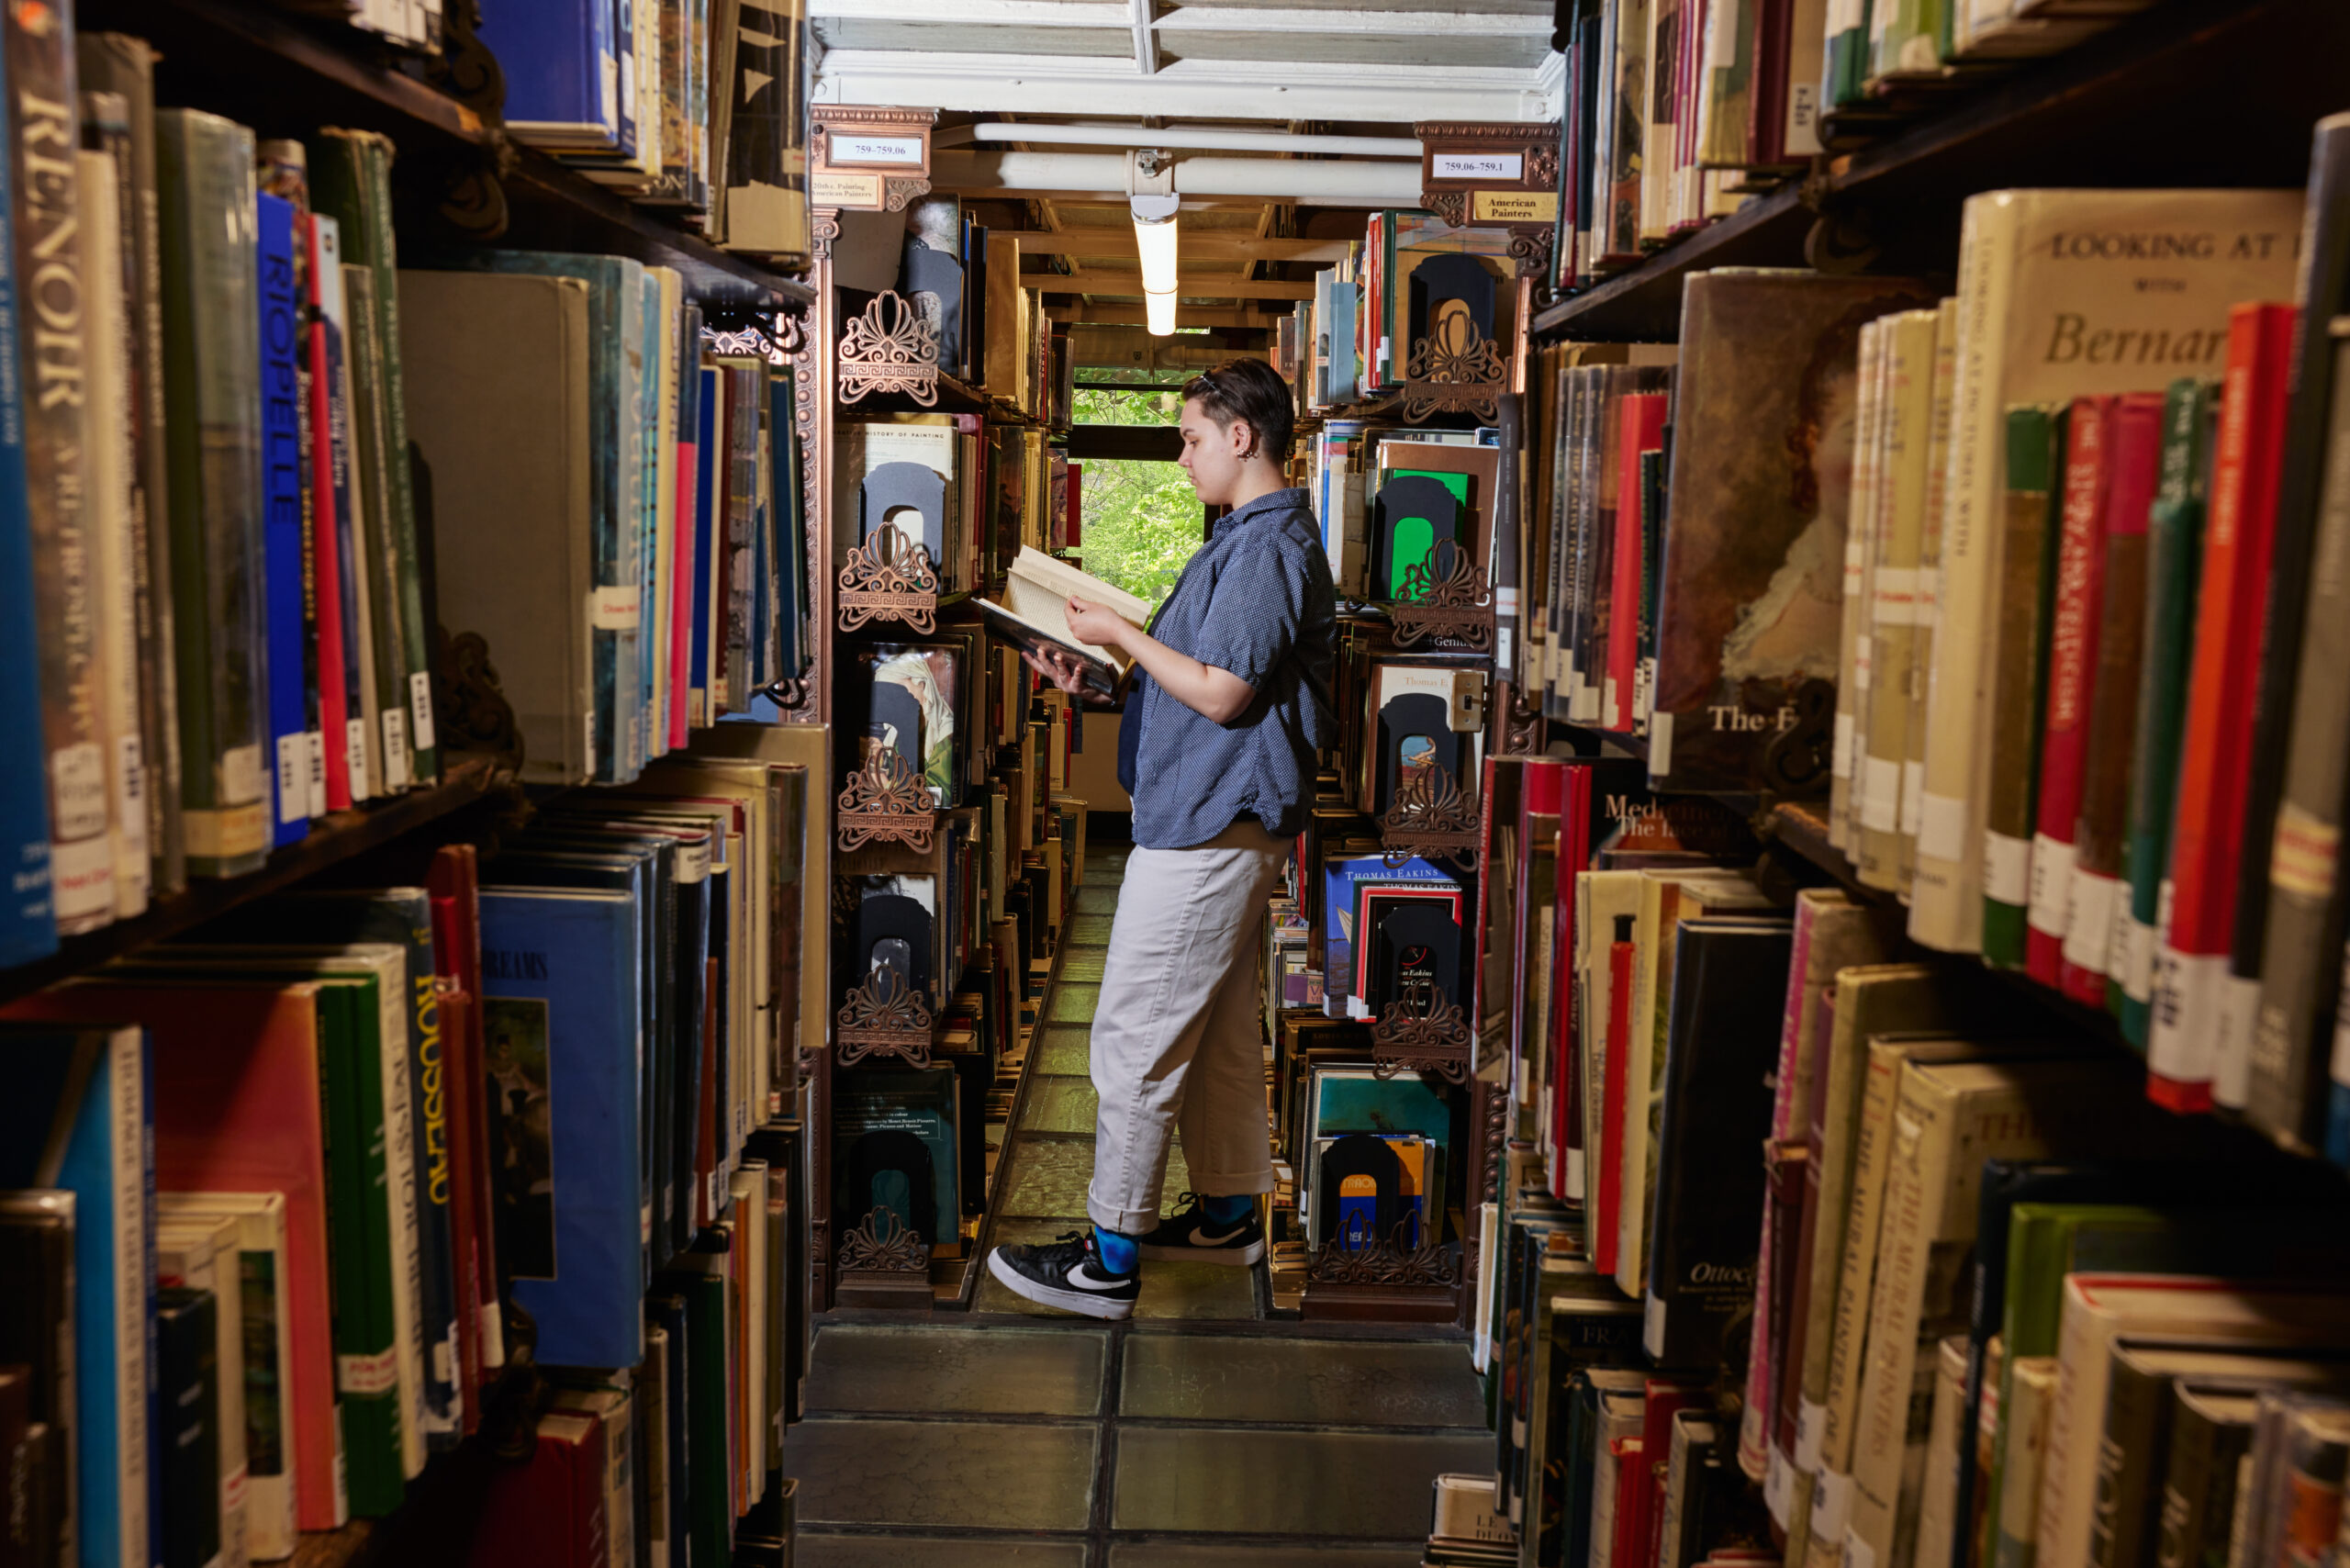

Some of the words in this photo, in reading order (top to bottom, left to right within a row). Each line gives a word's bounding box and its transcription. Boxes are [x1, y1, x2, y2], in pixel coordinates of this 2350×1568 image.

[1488, 198, 1536, 207] American
[1492, 208, 1533, 218] Painters
[19, 91, 84, 409] RENOIR
[2051, 230, 2215, 262] LOOKING
[2230, 232, 2280, 261] AT
[2133, 277, 2188, 294] WITH
[2043, 311, 2229, 365] Bernar
[266, 252, 297, 523] RIOPELLE
[1570, 479, 1581, 533] REALIST
[1566, 540, 1579, 610] TRADITION
[1434, 636, 1470, 647] Geniu
[1404, 677, 1438, 686] Thomas
[1707, 705, 1765, 731] The
[1346, 871, 1392, 881] THOMAS
[1397, 868, 1438, 878] EAKINS
[416, 974, 451, 1206] ROUSSEAU
[1856, 1128, 1874, 1174] THE
[1843, 1189, 1867, 1272] MURAL
[1902, 1180, 1922, 1235] THE
[1890, 1244, 1914, 1333] MURAL
[1828, 1288, 1854, 1402] PAINTERS
[1872, 1343, 1900, 1457] PAINTERS
